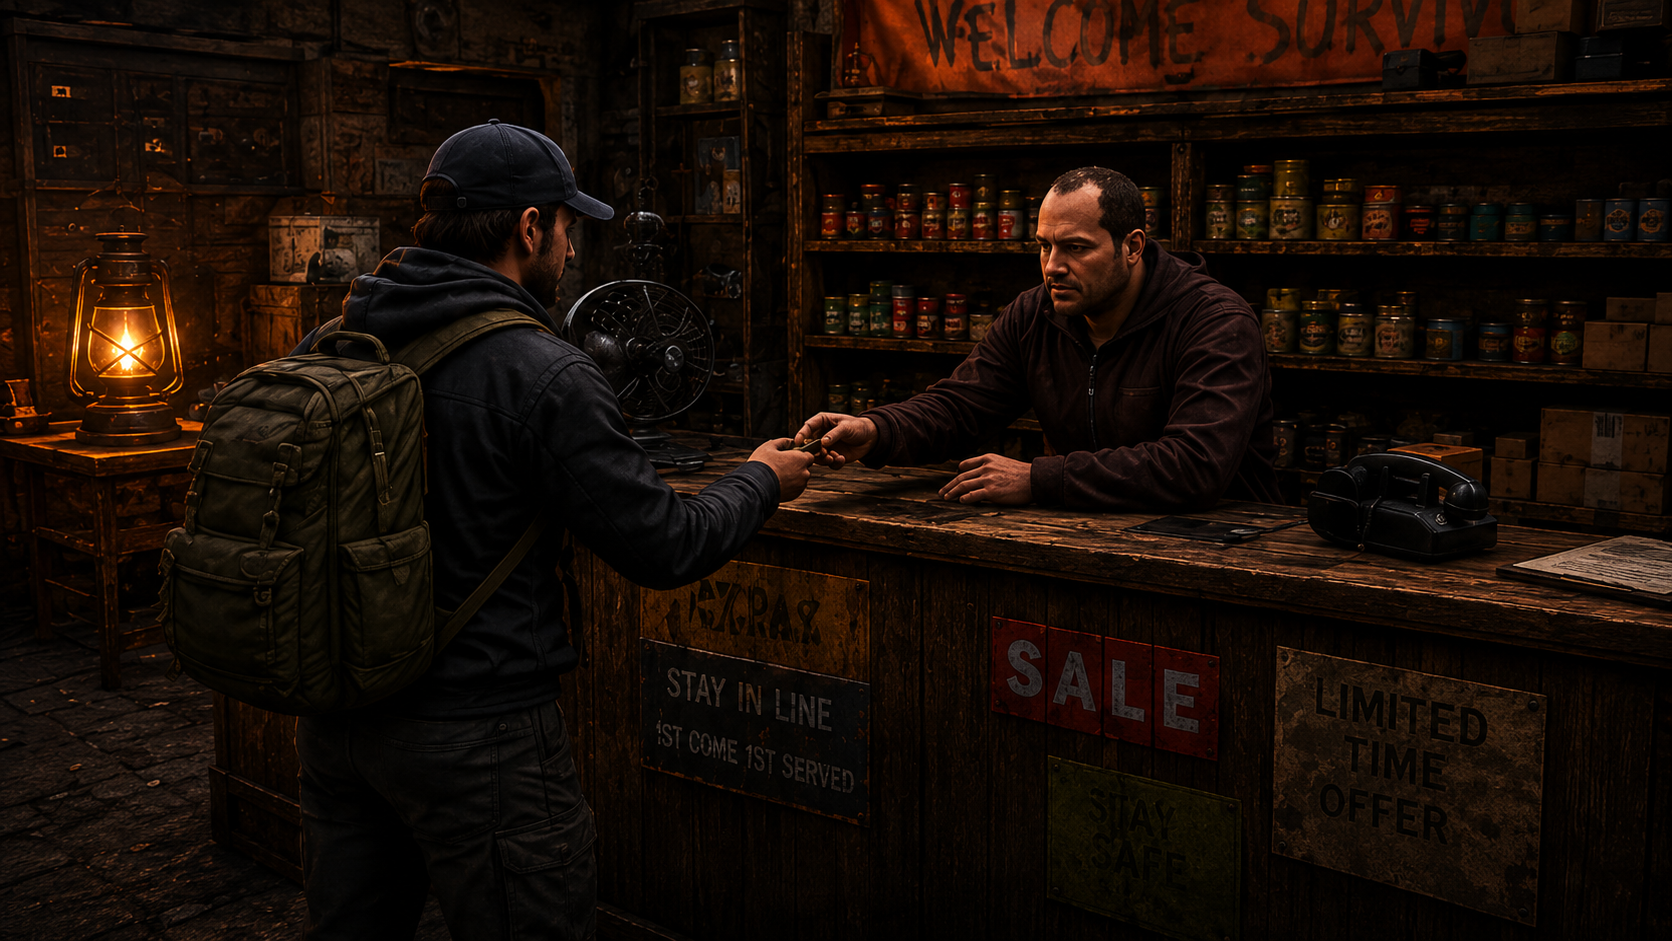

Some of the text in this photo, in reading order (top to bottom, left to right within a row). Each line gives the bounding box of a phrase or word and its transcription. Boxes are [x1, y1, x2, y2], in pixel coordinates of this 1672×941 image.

[914, 0, 1203, 71] WELCOME
[667, 666, 832, 732] STAY IN LINE
[1006, 639, 1200, 734] SALE
[1315, 677, 1488, 747] LIMITED
[656, 719, 855, 794] 1ST COME 1ST SERVED
[1345, 735, 1448, 792] TIME
[1088, 787, 1177, 840] STAY
[1320, 784, 1448, 845] OFFER
[1090, 832, 1187, 892] SAFE
